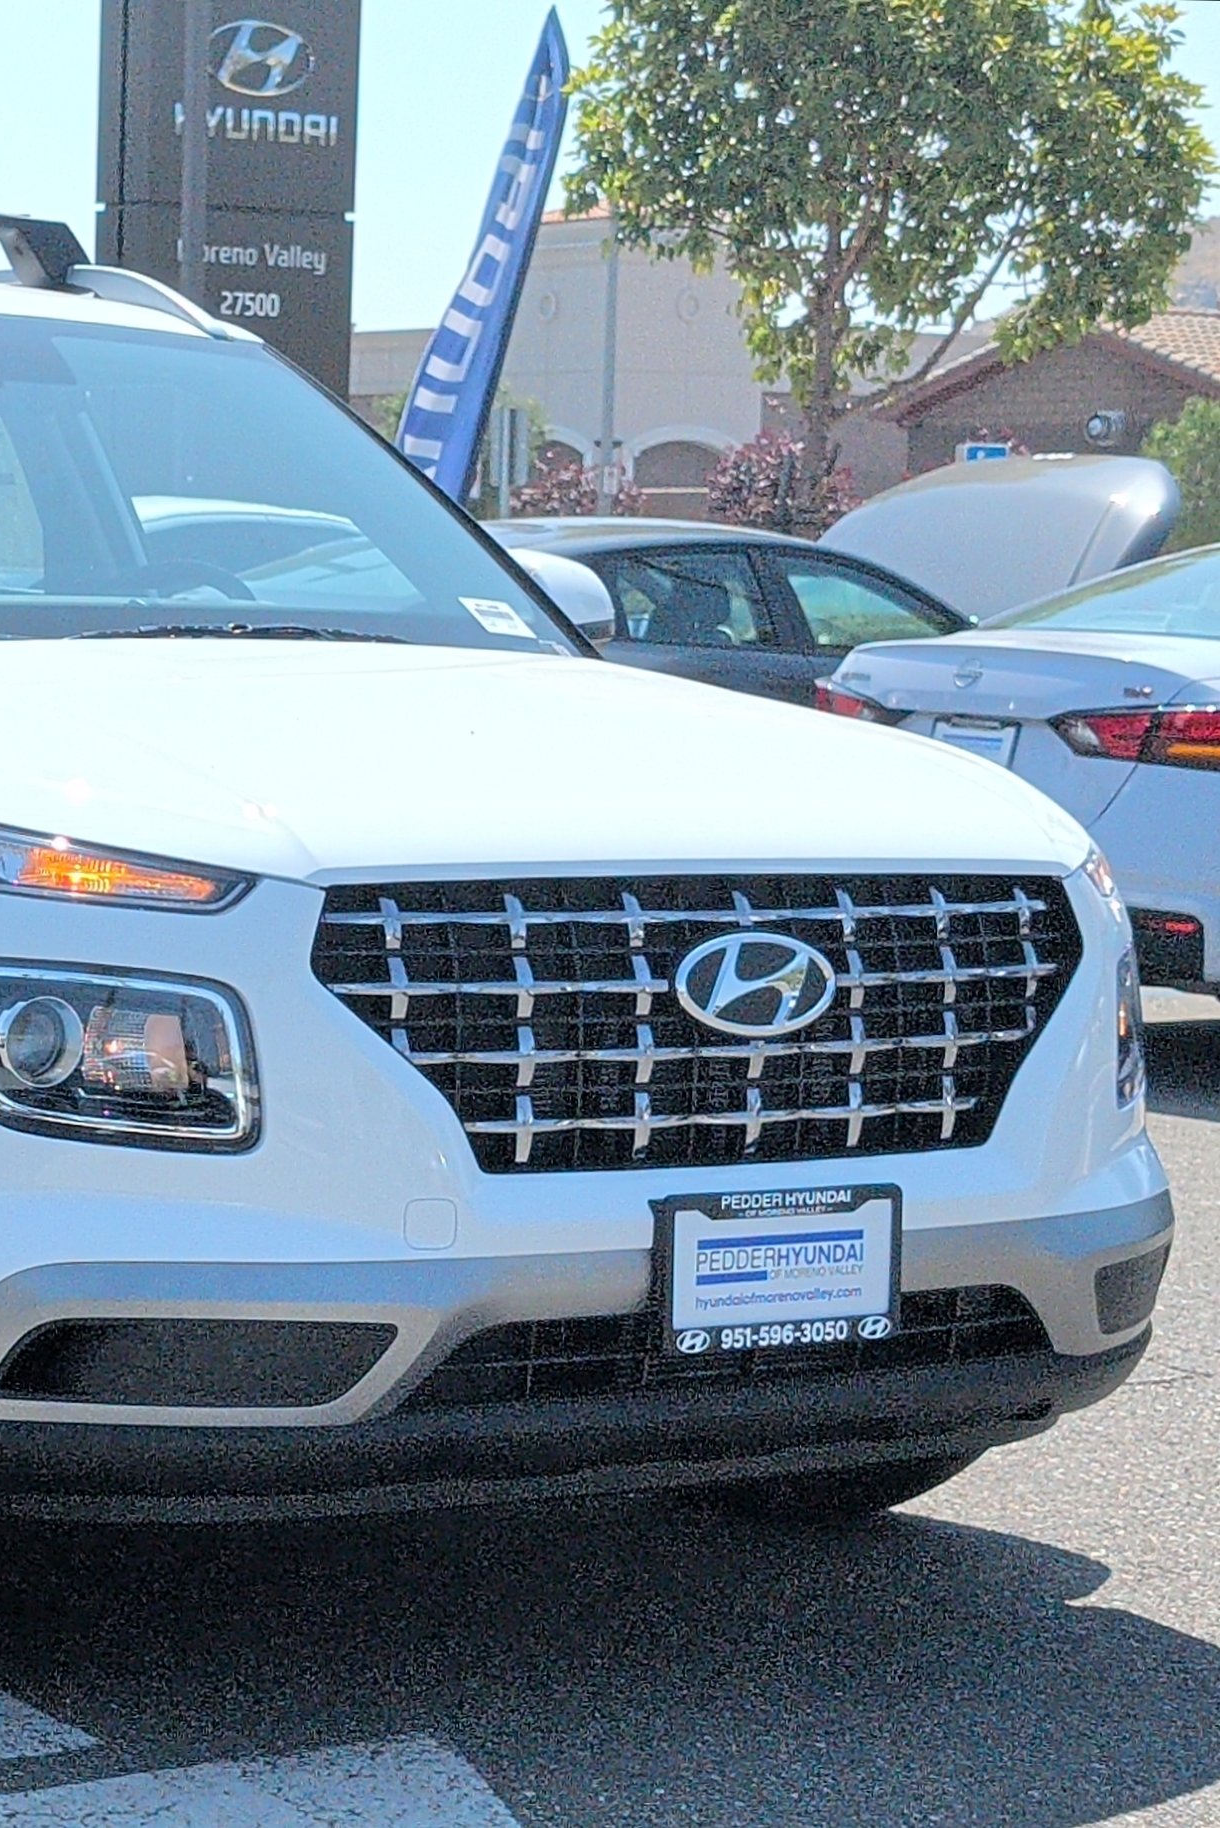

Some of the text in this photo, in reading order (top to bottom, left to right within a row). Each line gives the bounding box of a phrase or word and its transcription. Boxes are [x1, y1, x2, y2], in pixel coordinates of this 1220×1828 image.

[264, 243, 327, 276] Valley
[219, 290, 281, 318] 27500
[721, 1189, 852, 1210] PEDDER HYUNDAI
[769, 1264, 864, 1281] OF MORENO VALLEY
[694, 1286, 863, 1311] hyundaiofmorenovalley.com
[720, 1320, 849, 1350] 951-596-3050
